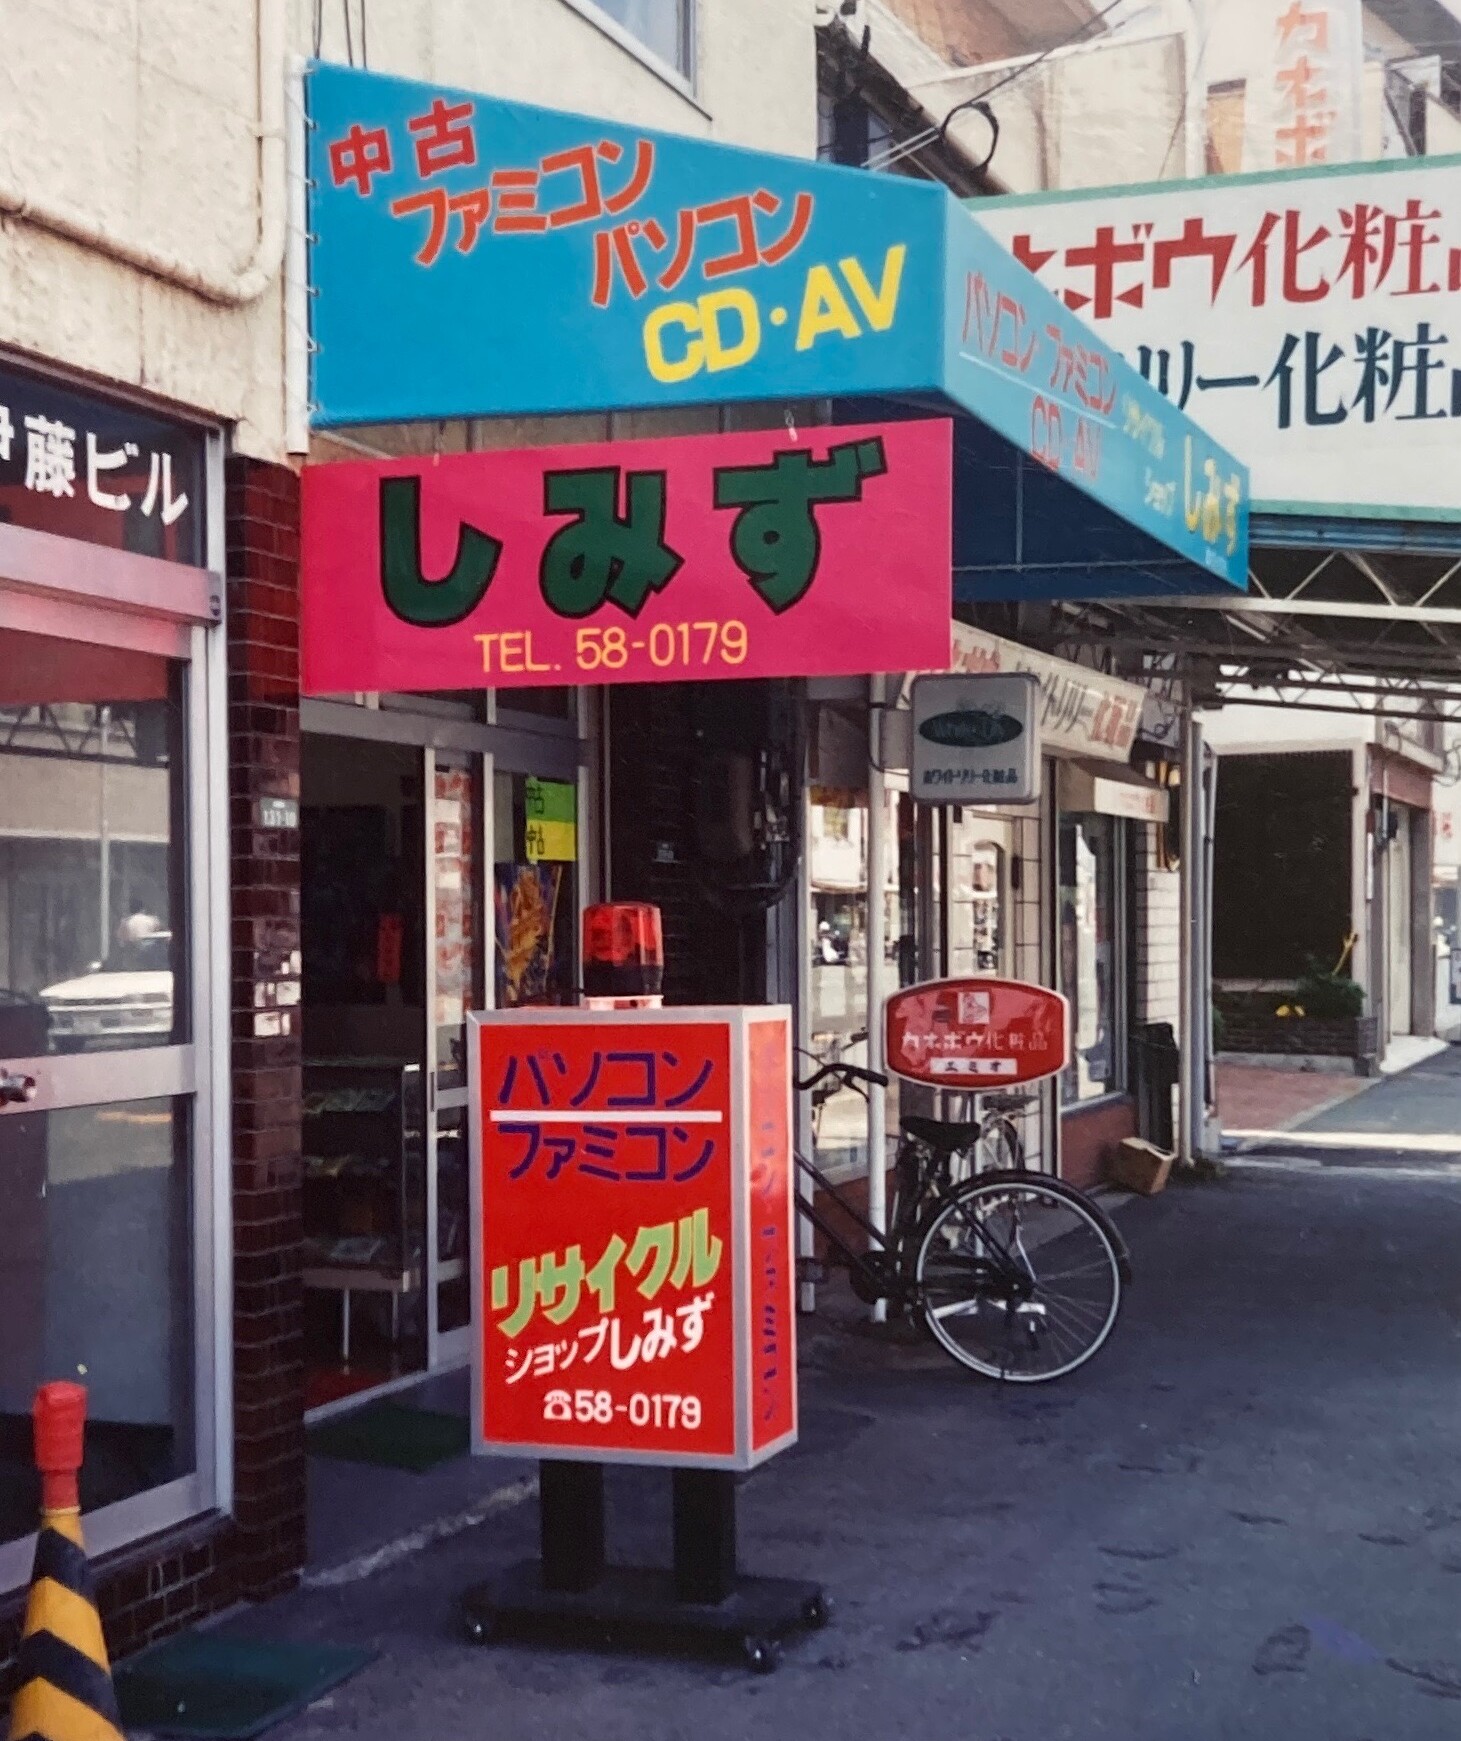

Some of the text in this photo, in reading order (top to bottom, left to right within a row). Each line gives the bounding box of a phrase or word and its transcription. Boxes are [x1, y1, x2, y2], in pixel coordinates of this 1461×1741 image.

[328, 99, 478, 197] 中古
[391, 139, 656, 267] ファミコン
[591, 187, 814, 308] パソコン
[962, 271, 1039, 375] パソコン
[379, 435, 889, 628] しみず
[474, 619, 749, 674] TEL. 58-0179
[497, 1049, 715, 1107] パソコン
[497, 1122, 715, 1183] ファミコン
[491, 1207, 723, 1339] リサイクル
[504, 1292, 715, 1385] ショップしみず
[574, 1388, 702, 1430] 58-0179
